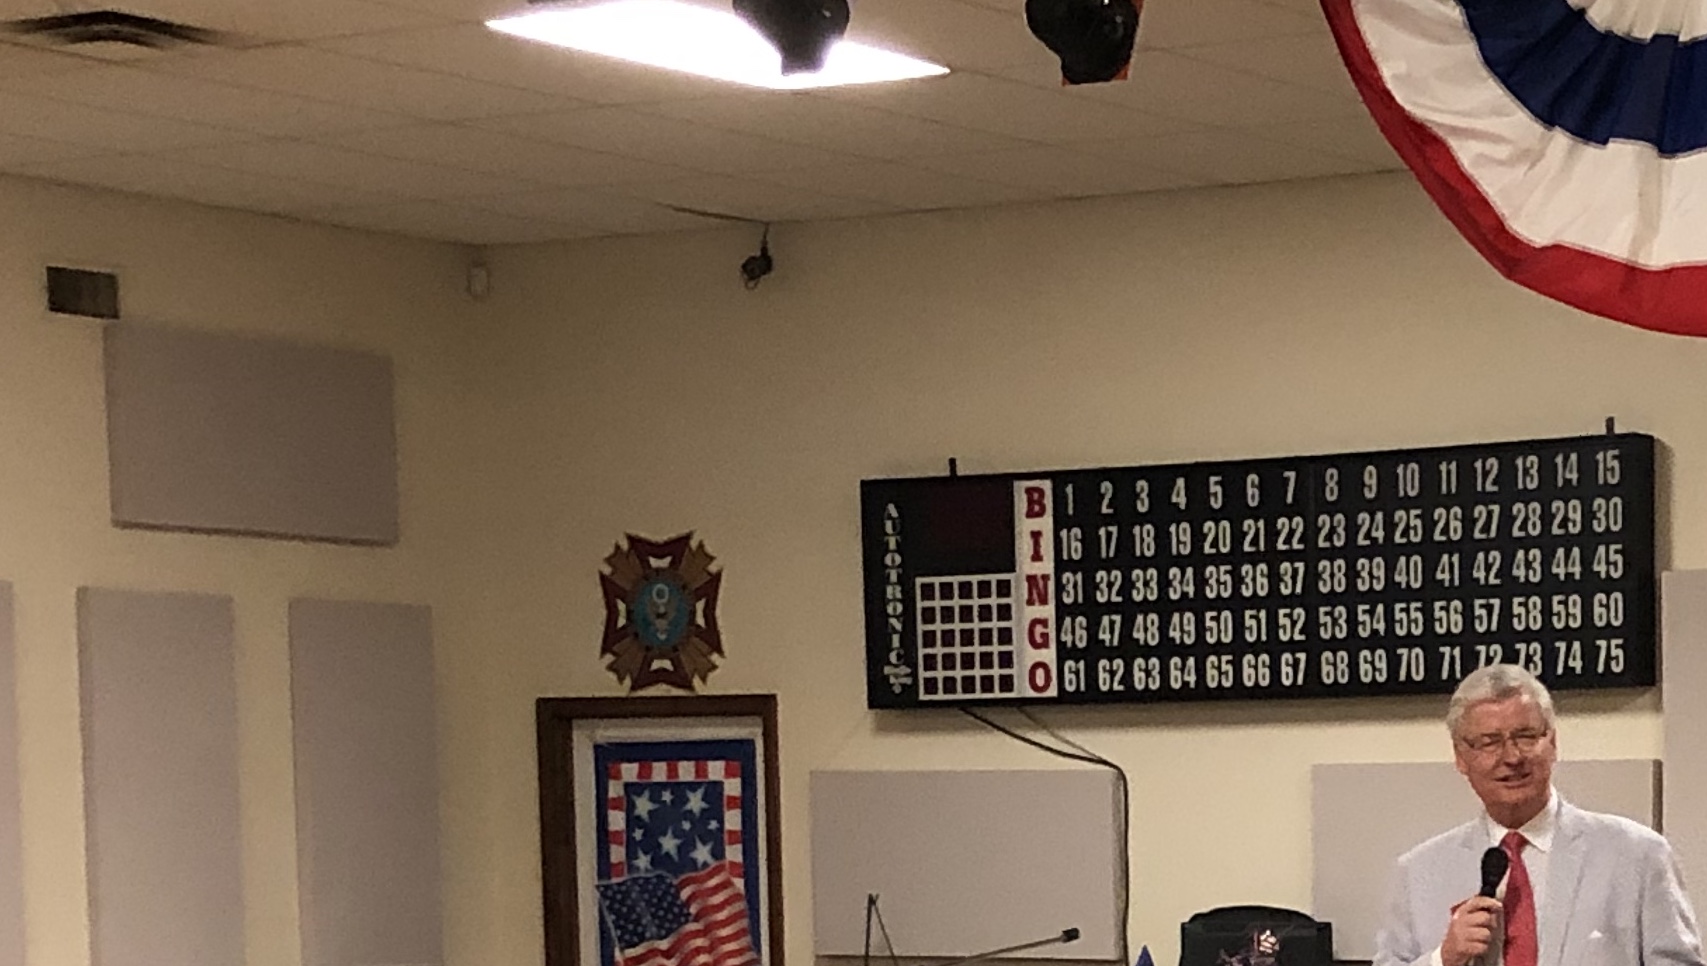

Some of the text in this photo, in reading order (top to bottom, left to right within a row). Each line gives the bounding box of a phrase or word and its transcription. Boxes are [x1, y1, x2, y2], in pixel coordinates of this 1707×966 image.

[1065, 449, 1620, 515] 1 2 3 4 5 6 7 8 9 10 11 12 13 14 15
[1059, 496, 1623, 561] 16 17 18 19 20 21 22 23 24 25 26 27 28 29 30
[883, 502, 905, 665] AUTOTRONIC
[1024, 486, 1052, 693] BINGO
[1062, 543, 1623, 604] 31 32 33 34 35 36 37 38 39 40 41 42 43 44 45
[1060, 591, 1624, 649] 46 47 48 49 50 51 52 53 54 55 56 57 58 59 60
[1063, 638, 1624, 693] 61 62 63 64 65 66 67 68 69 70 71 72 73 74 75
